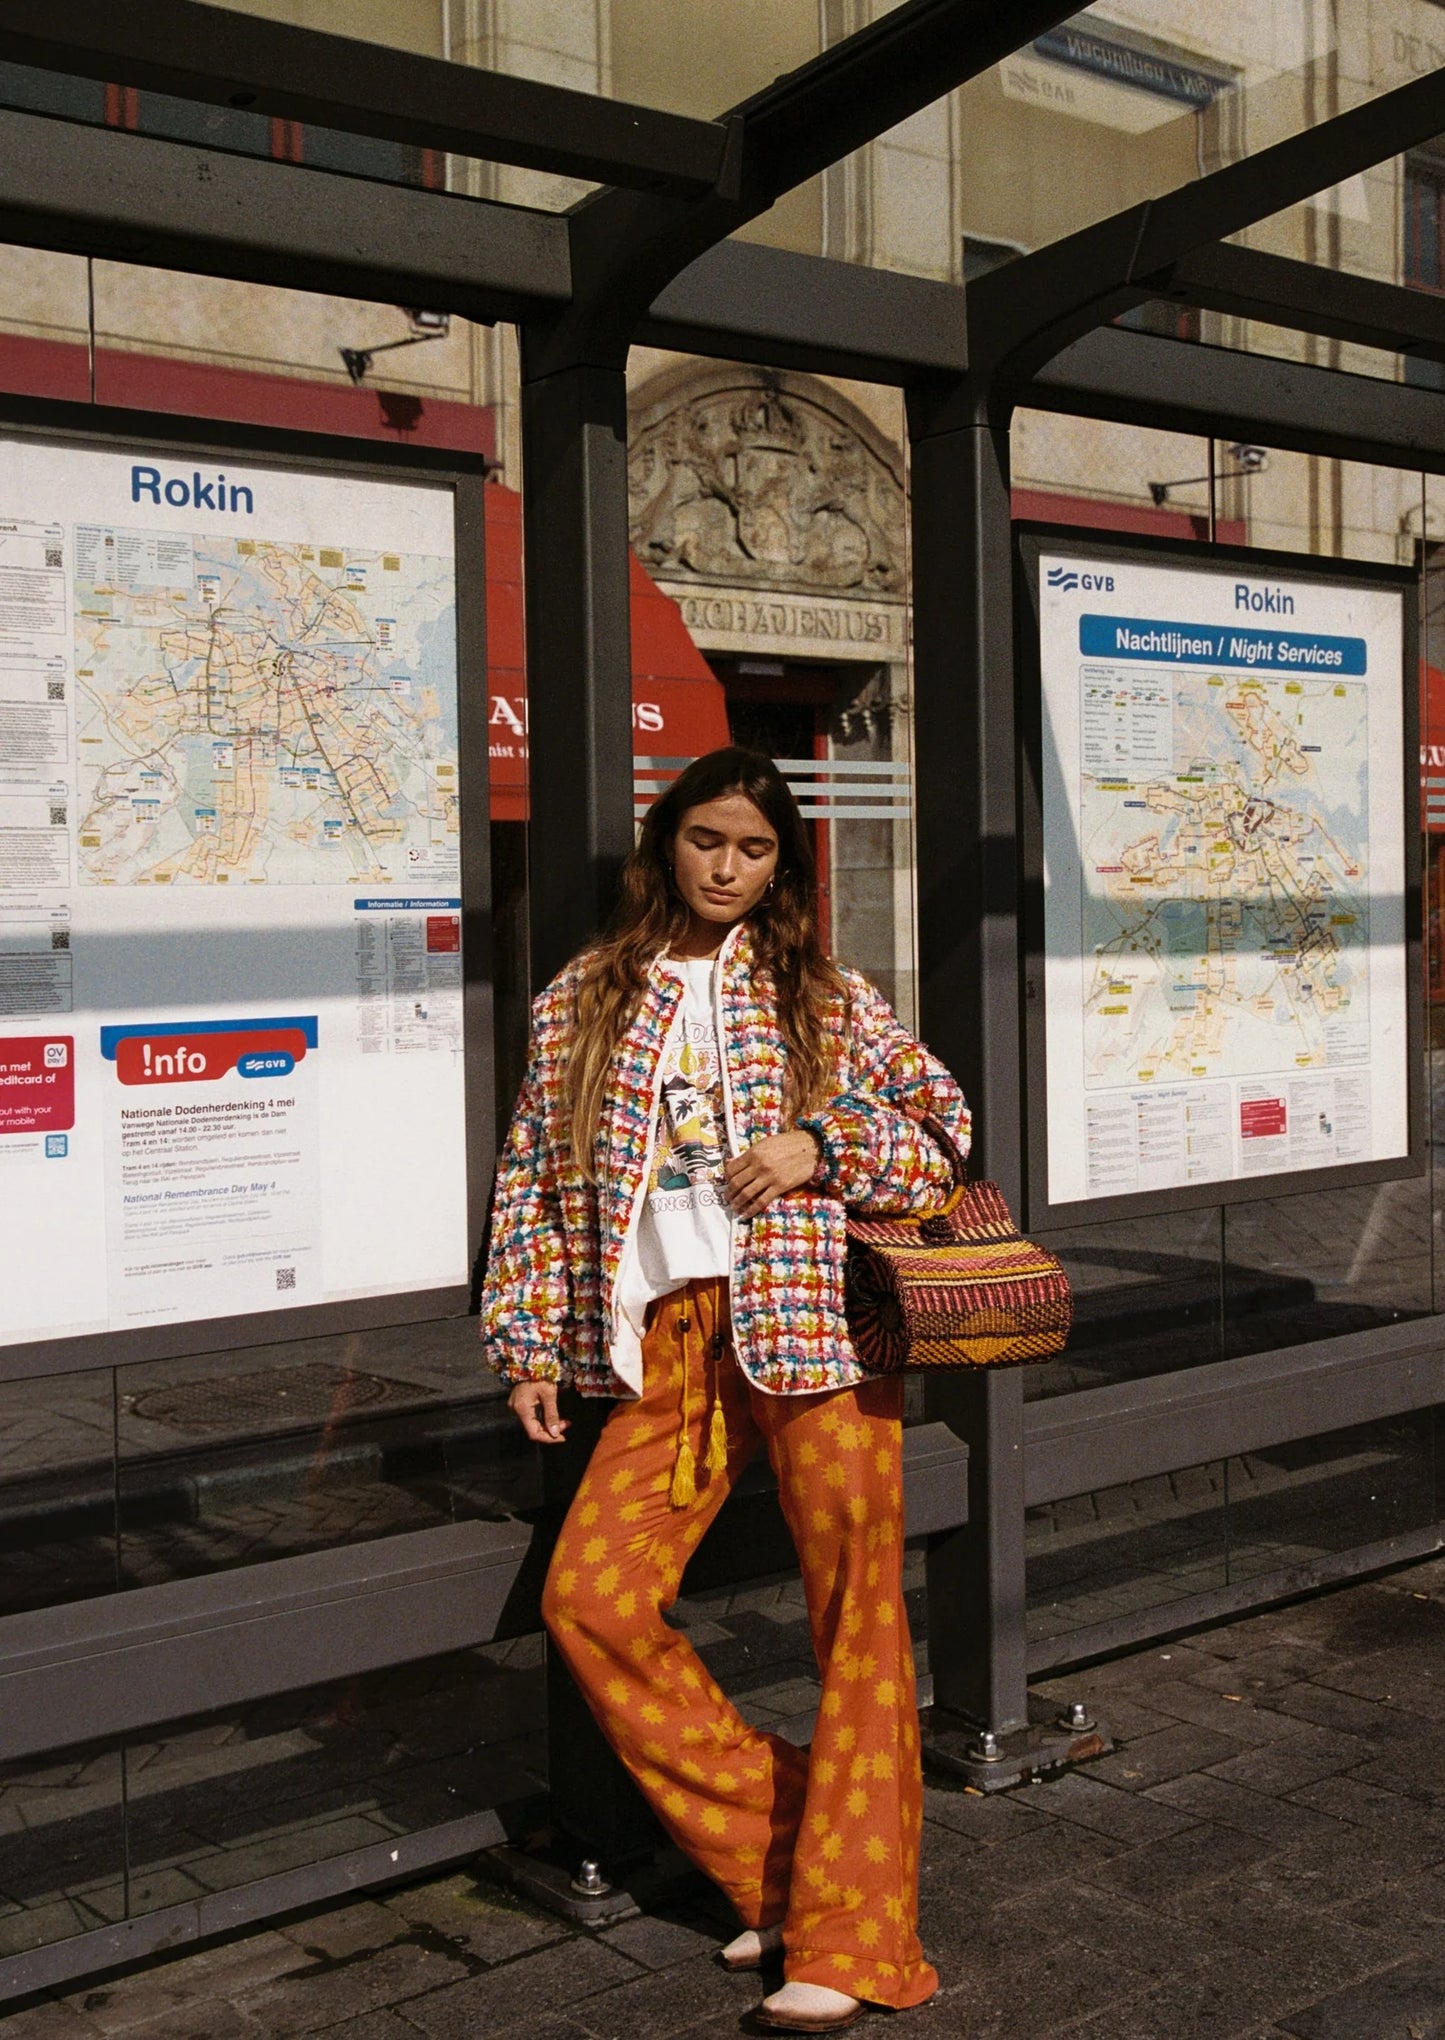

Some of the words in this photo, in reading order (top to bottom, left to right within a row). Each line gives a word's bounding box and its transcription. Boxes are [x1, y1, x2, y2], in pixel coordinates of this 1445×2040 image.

[130, 466, 254, 514] Rokin
[1081, 575, 1114, 591] GVB
[1235, 584, 1294, 615] Rokin
[1116, 628, 1212, 658] Nachtlijnen
[1217, 637, 1224, 656] /
[1229, 638, 1273, 664] Night
[1277, 642, 1343, 666] Services
[47, 1047, 64, 1058] OV
[10, 1062, 31, 1071] met
[266, 1059, 286, 1069] GVB
[45, 1073, 56, 1083] of
[14, 1106, 31, 1114] with
[34, 1106, 52, 1115] your
[121, 1106, 172, 1119] Nationale
[175, 1099, 264, 1116] Dodenherdenking
[268, 1099, 272, 1107] 4
[276, 1098, 294, 1106] mei
[7, 1117, 35, 1125] mobile
[121, 1120, 155, 1130] Vanwege
[156, 1117, 190, 1126] Nationale
[191, 1112, 252, 1124] Dodenherdenking
[121, 1129, 156, 1138] gestremd
[157, 1127, 177, 1135] vanaf
[123, 1192, 162, 1203] National
[165, 1186, 228, 1199] Remembrance
[231, 1184, 249, 1194] Day
[250, 1182, 267, 1192] May
[270, 1181, 276, 1189] 4
